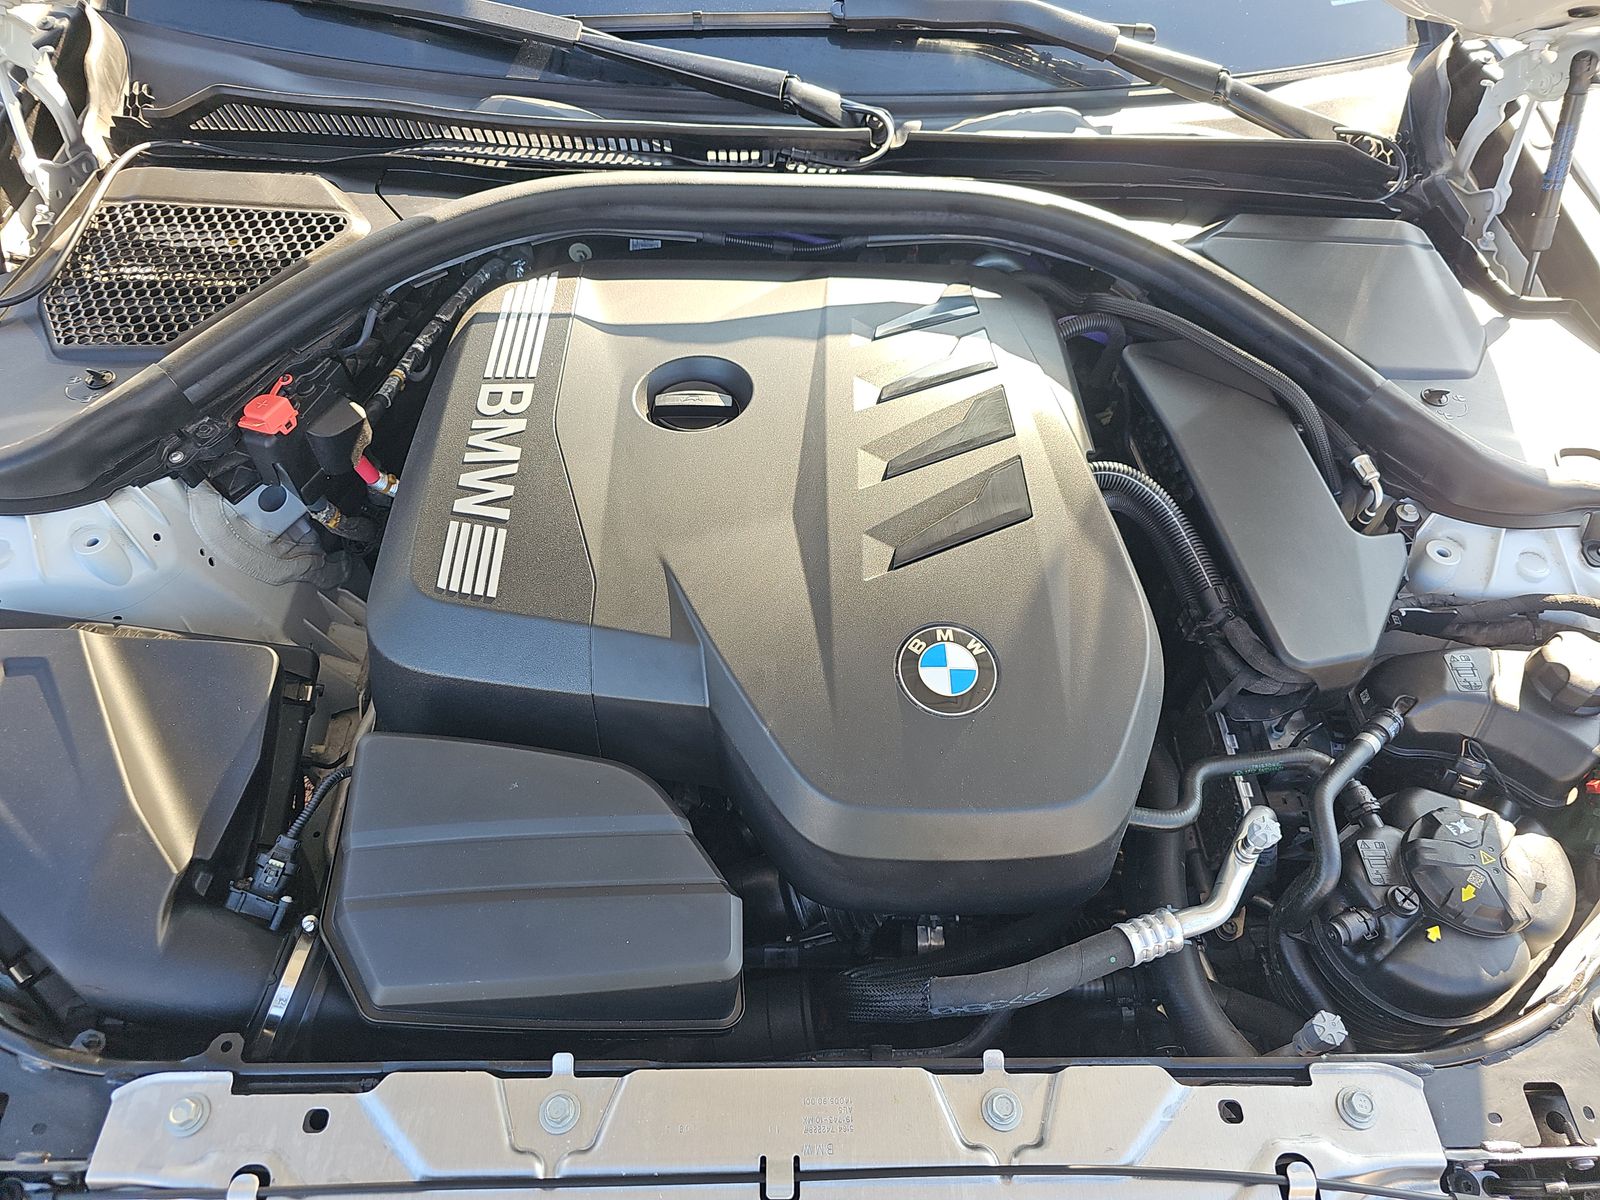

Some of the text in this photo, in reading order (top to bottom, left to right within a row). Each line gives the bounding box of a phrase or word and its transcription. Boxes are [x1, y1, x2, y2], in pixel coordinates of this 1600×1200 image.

[452, 383, 535, 521] BMW
[907, 628, 987, 656] BMW
[801, 1143, 834, 1156] BMW
